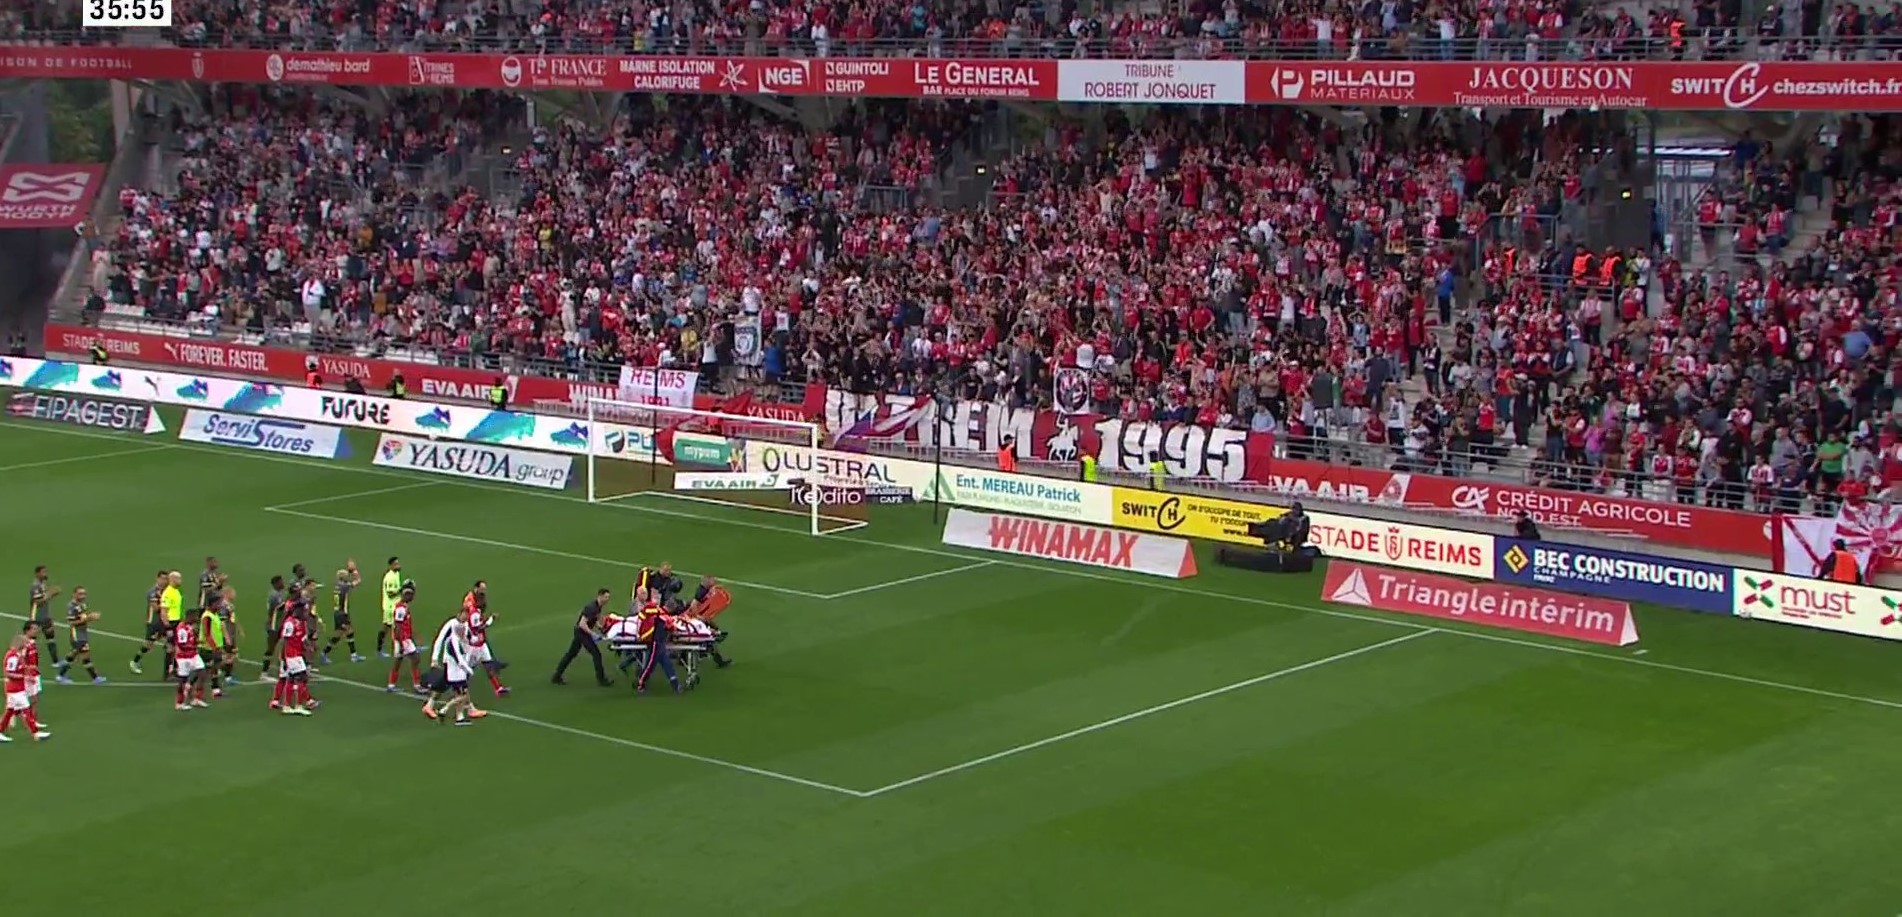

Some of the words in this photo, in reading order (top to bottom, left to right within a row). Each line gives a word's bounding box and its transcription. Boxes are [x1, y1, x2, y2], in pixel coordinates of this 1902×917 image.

[45, 57, 63, 67] DE
[71, 57, 132, 69] FOOTBALL
[287, 57, 341, 71] demathieu
[344, 59, 370, 72] bard
[551, 58, 607, 75] FRANCE
[620, 60, 656, 73] MARNE
[658, 61, 715, 75] ISOLATION
[836, 62, 889, 76] GUINTOLI
[1125, 64, 1174, 78] TRIBUNE
[634, 75, 700, 90] CALORIFUGE
[764, 67, 803, 85] NGE
[1311, 69, 1415, 87] PILLAUD
[1469, 67, 1633, 93] JACQUESON
[836, 80, 865, 92] EHTP
[923, 86, 942, 95] BAR
[1084, 82, 1138, 98] ROBERT
[1144, 83, 1216, 99] JONQUET
[1310, 88, 1415, 100] MATERIAUX
[1773, 78, 1901, 95] chezswitch.fr
[1453, 91, 1508, 107] Transport
[1509, 94, 1521, 105] et
[1523, 93, 1578, 107] Tourisme
[1597, 94, 1648, 107] Autocar
[62, 333, 96, 350] STADE
[107, 338, 140, 355] REIMS
[181, 343, 227, 367] FOREVER.
[228, 348, 269, 371] FASTER.
[323, 358, 371, 379] YASUDA
[422, 378, 459, 396] EVA
[630, 368, 687, 389] REMS
[32, 395, 144, 430] FIPAGEST
[746, 405, 805, 422] YASUDA
[1094, 418, 1248, 482] 1995
[409, 443, 511, 479] YASUDA
[515, 463, 565, 485] group
[956, 474, 980, 489] Ent.
[982, 478, 1034, 496] MEREAU
[1037, 485, 1081, 503] Patrick
[1496, 488, 1572, 513] CRÉDIT
[1578, 500, 1691, 528] AGRICOLE
[1549, 513, 1583, 526] EST
[988, 516, 1140, 568] WINAMAX
[1310, 524, 1379, 552] STADE
[1408, 538, 1482, 567] REIMS
[1533, 566, 1611, 584] CHAMPAGNE
[1534, 549, 1569, 570] BEC
[1573, 554, 1724, 593] CONSTRUCTION
[1378, 574, 1496, 616] Triangle
[1501, 592, 1614, 632] intérim
[1781, 586, 1856, 614] must
